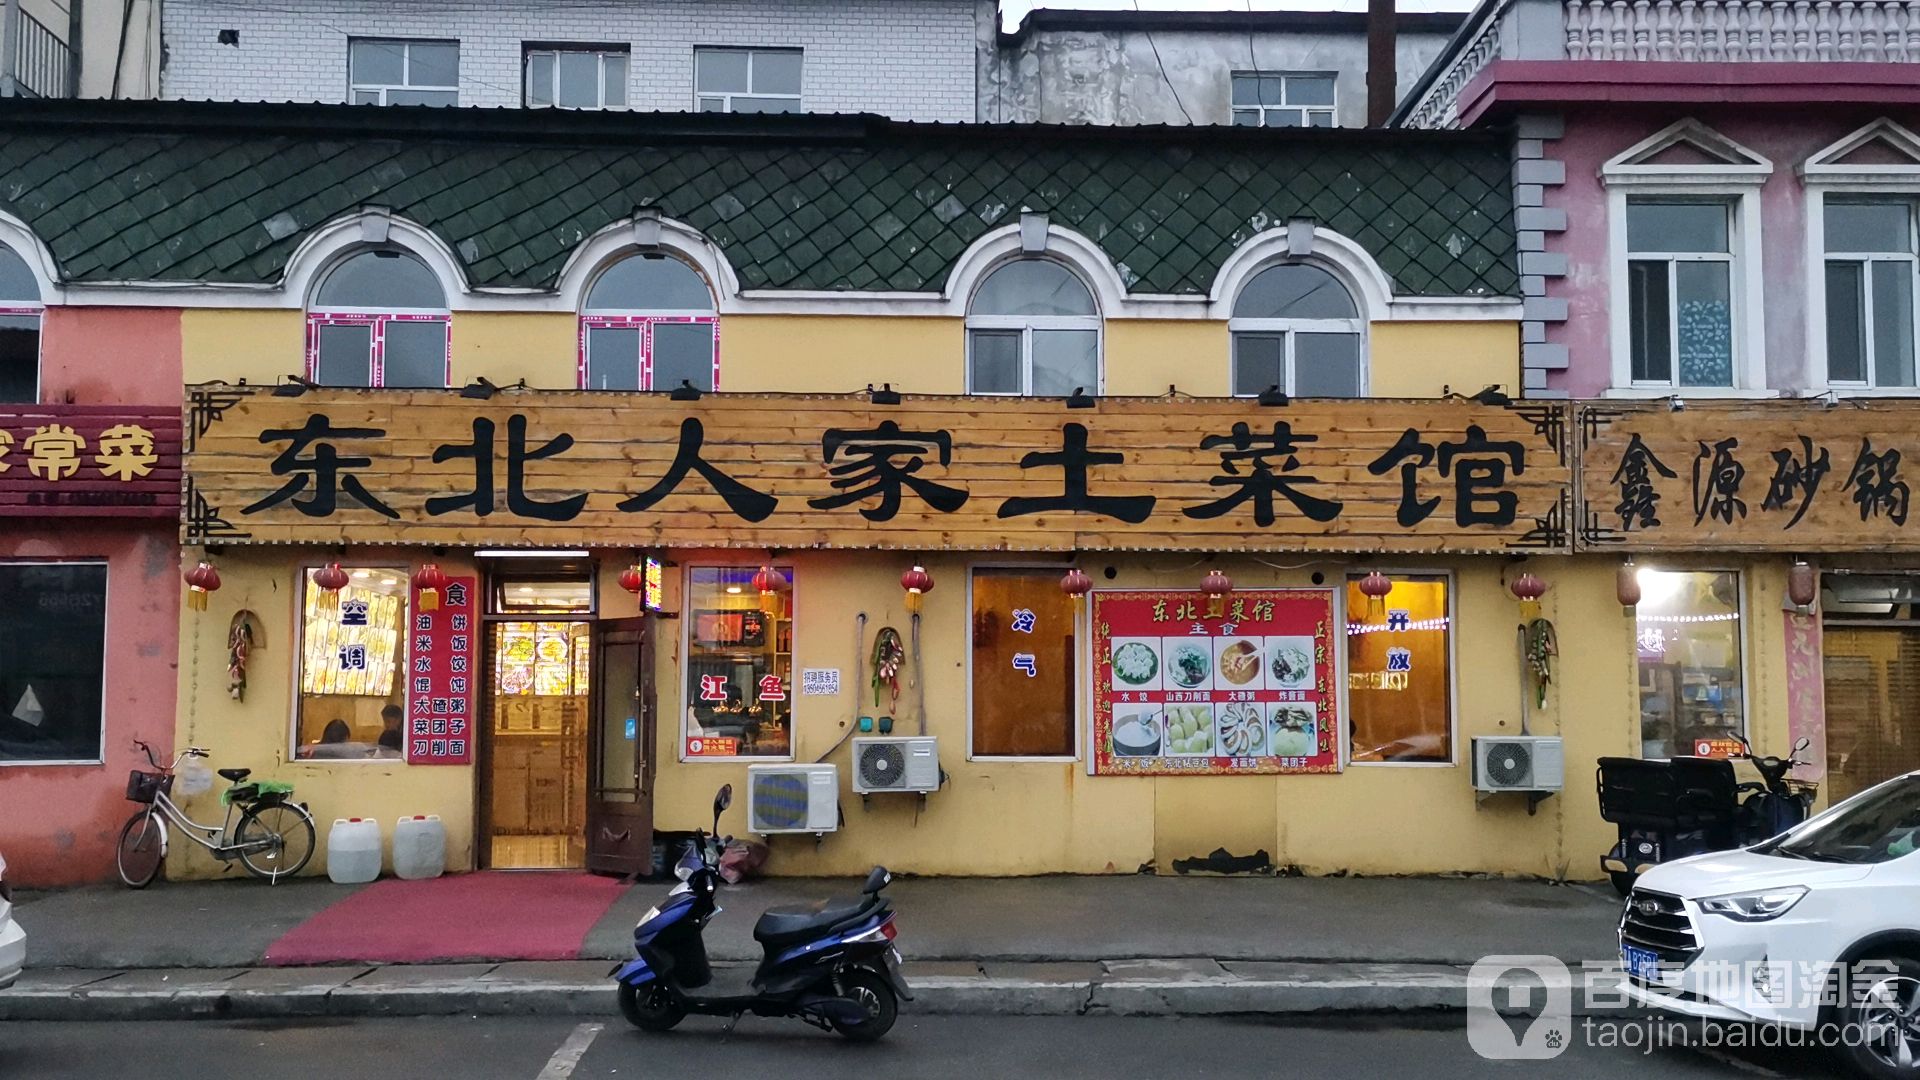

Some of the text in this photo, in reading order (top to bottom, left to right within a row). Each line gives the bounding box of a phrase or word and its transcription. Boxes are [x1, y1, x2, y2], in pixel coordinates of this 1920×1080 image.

[0, 424, 157, 481] 常菜
[240, 413, 1525, 528] 东北人家土菜馆
[1610, 431, 1911, 531] 鑫源砂锅
[1153, 599, 1275, 622] 东北土菜馆
[339, 600, 368, 670] 空调
[1189, 622, 1239, 635] 主食
[1387, 609, 1411, 672] 开放
[1012, 609, 1036, 676] 冷气
[701, 674, 786, 701] 江鱼
[1121, 691, 1148, 701] 水饺
[1166, 691, 1211, 701] 山西刀削面
[414, 699, 465, 714] 大碴粥
[413, 720, 465, 735] 菜团子
[413, 741, 464, 756] 刀削面
